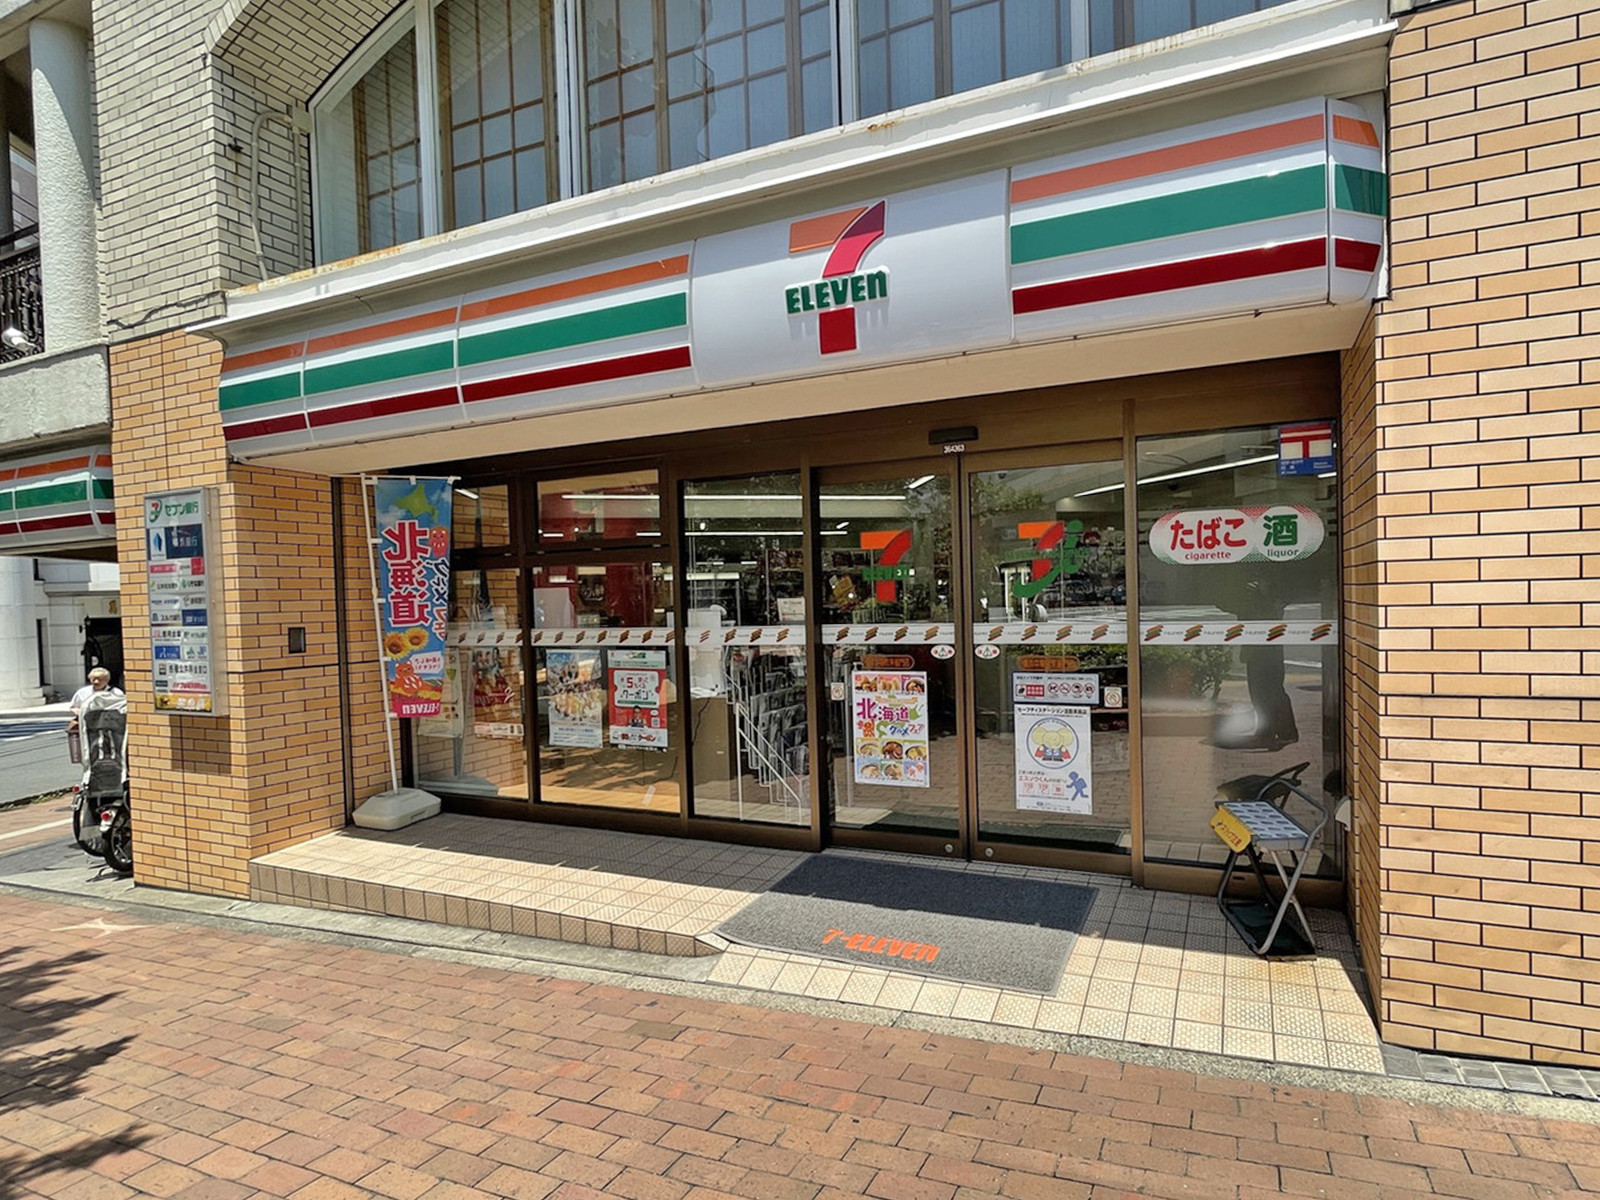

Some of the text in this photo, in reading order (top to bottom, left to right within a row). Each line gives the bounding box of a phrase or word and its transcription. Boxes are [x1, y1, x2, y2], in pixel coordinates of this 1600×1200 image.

[786, 270, 888, 314] ELEVEN
[789, 200, 886, 355] 7
[165, 501, 199, 516] セブン銀行
[1170, 514, 1298, 550] たばこ 酒
[1185, 548, 1299, 561] cigarette liquor
[856, 697, 910, 723] 北海道
[821, 928, 941, 963] 7-ELEVEN
